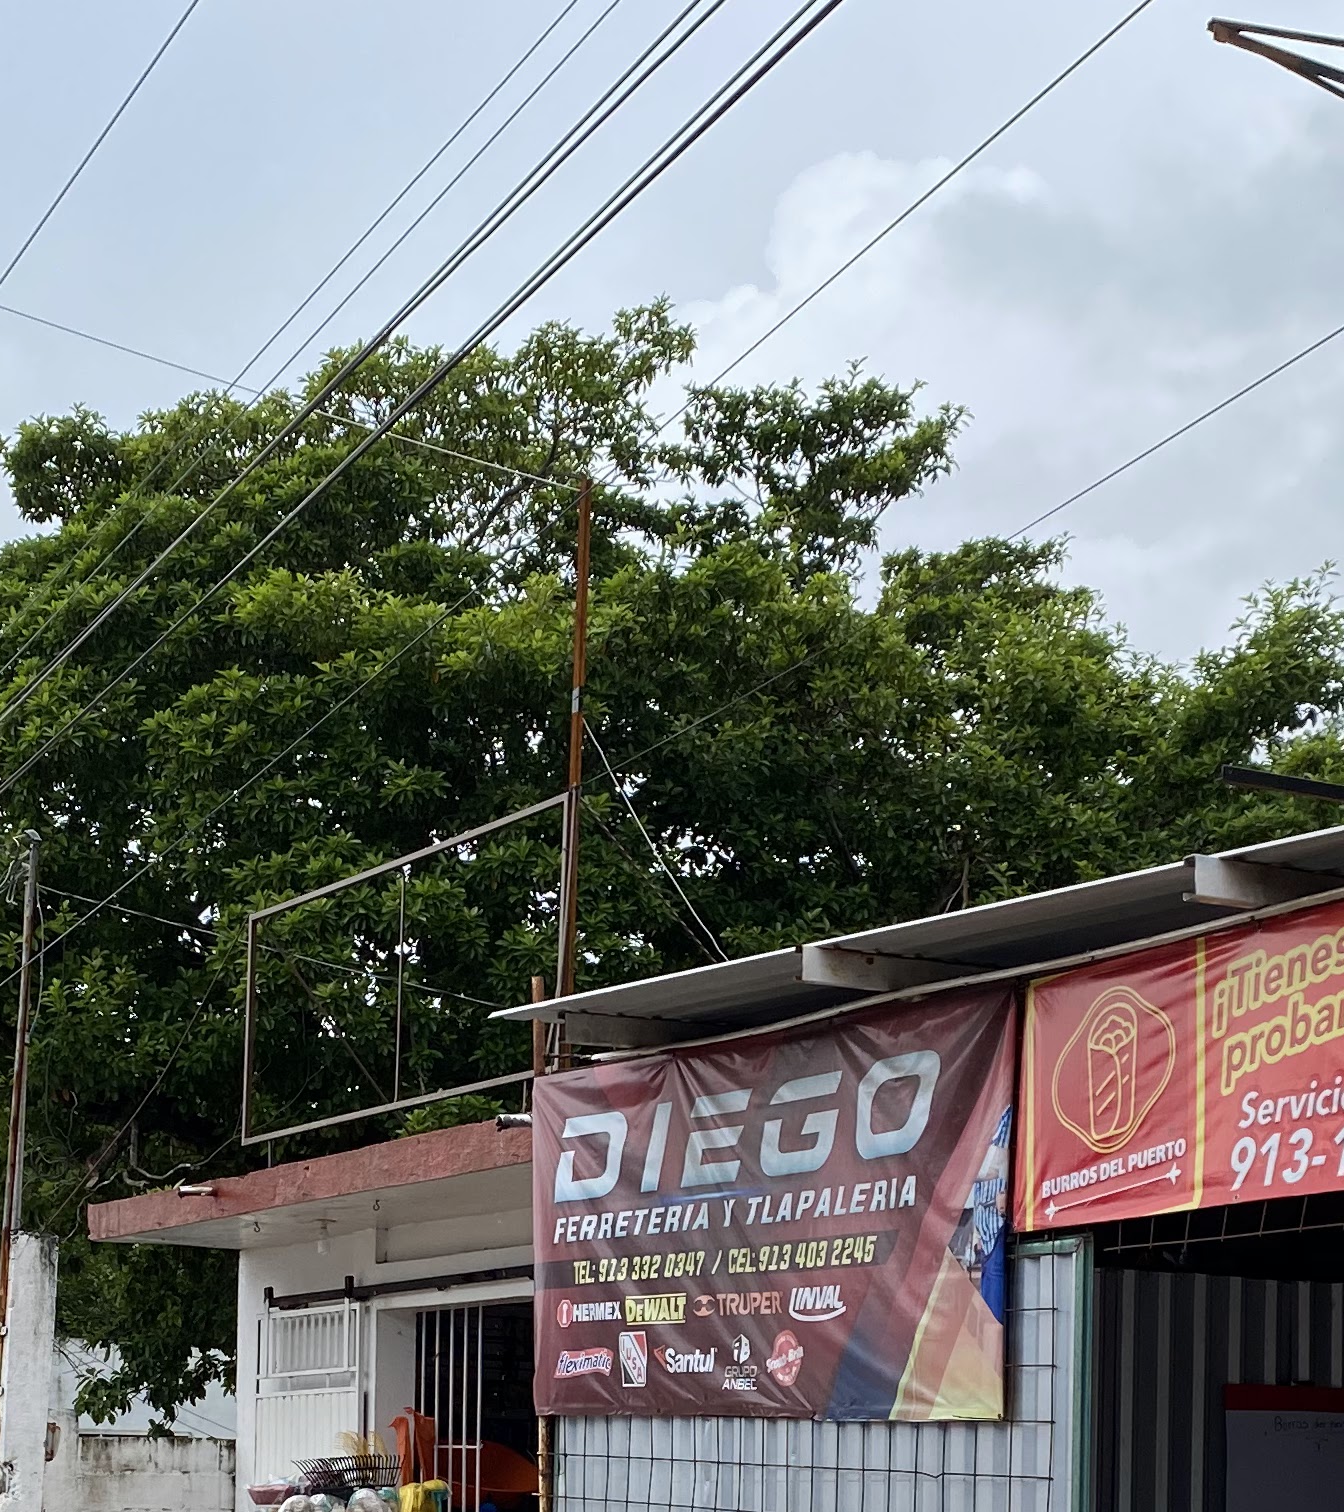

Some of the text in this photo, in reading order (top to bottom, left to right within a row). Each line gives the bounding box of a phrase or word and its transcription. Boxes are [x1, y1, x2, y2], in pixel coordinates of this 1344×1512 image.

[554, 1049, 941, 1203] DIEGO
[1042, 1138, 1187, 1199] BURROS DEL PUERTO
[553, 1175, 917, 1245] FERRETERIA Y TLAPALERIA
[573, 1235, 878, 1285] TEL: 913 332 0347 / CEL: 913 403 2245
[572, 1301, 622, 1322] HERMEX
[717, 1292, 782, 1317] TRUPER
[557, 1350, 612, 1376] fleximatic
[665, 1347, 715, 1374] Santul
[724, 1365, 758, 1379] GRUPO
